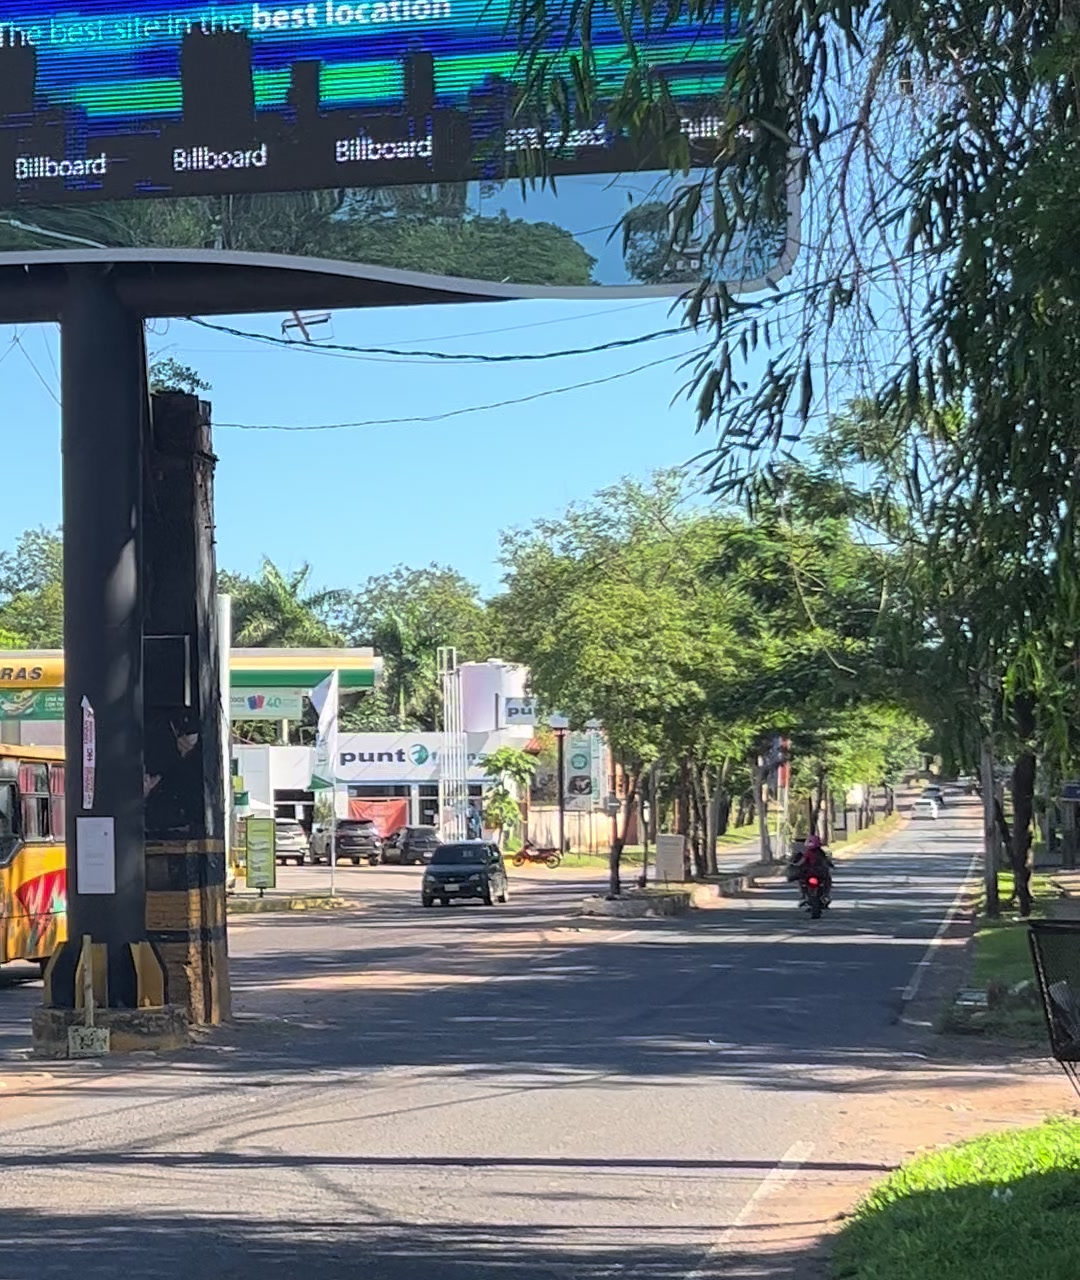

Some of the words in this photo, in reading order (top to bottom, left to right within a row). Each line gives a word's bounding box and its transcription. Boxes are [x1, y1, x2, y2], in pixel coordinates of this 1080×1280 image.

[49, 18, 104, 44] best
[114, 16, 160, 40] site
[168, 14, 192, 35] in
[201, 7, 244, 35] the
[252, 3, 317, 31] best
[15, 153, 107, 180] Billboard
[172, 144, 268, 171] Billboard
[335, 135, 433, 162] Billboard
